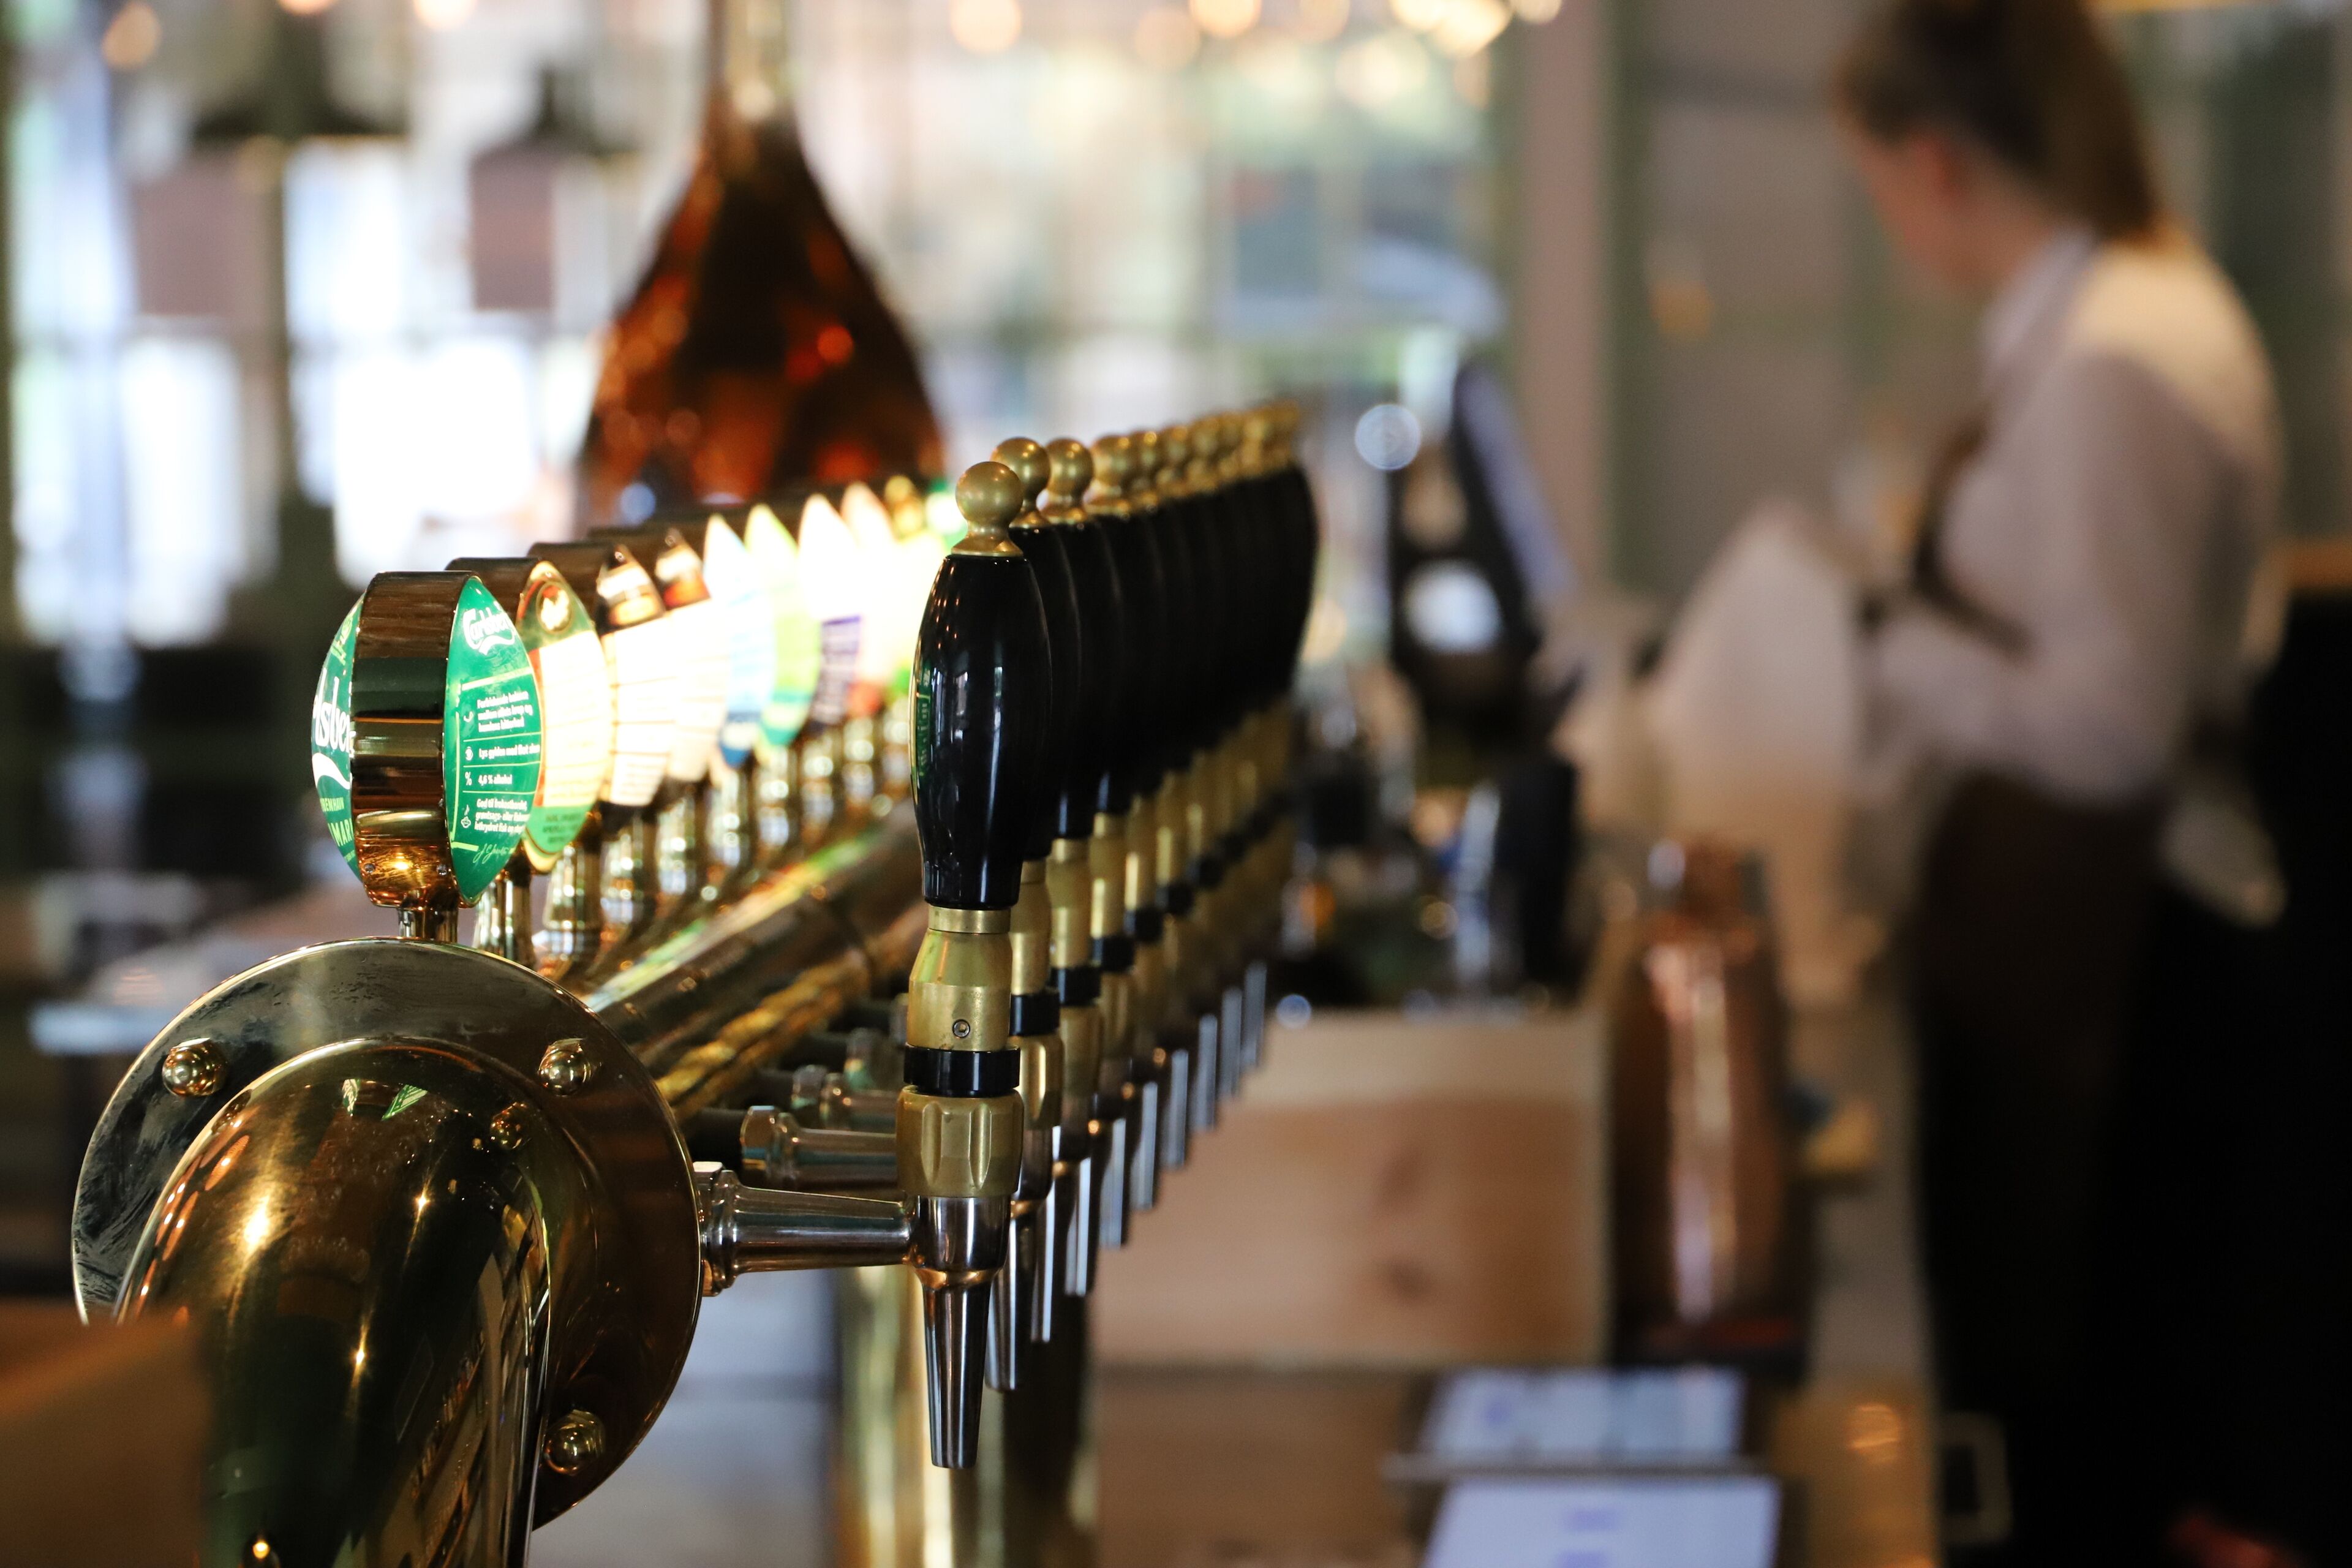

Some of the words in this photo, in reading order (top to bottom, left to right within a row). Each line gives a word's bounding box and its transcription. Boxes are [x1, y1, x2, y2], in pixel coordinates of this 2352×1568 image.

[524, 704, 533, 715] og
[479, 748, 488, 760] Lys
[506, 744, 518, 756] med
[478, 775, 488, 786] 4,6
[488, 775, 494, 784] %
[494, 774, 513, 785] alkohol
[477, 798, 488, 808] God
